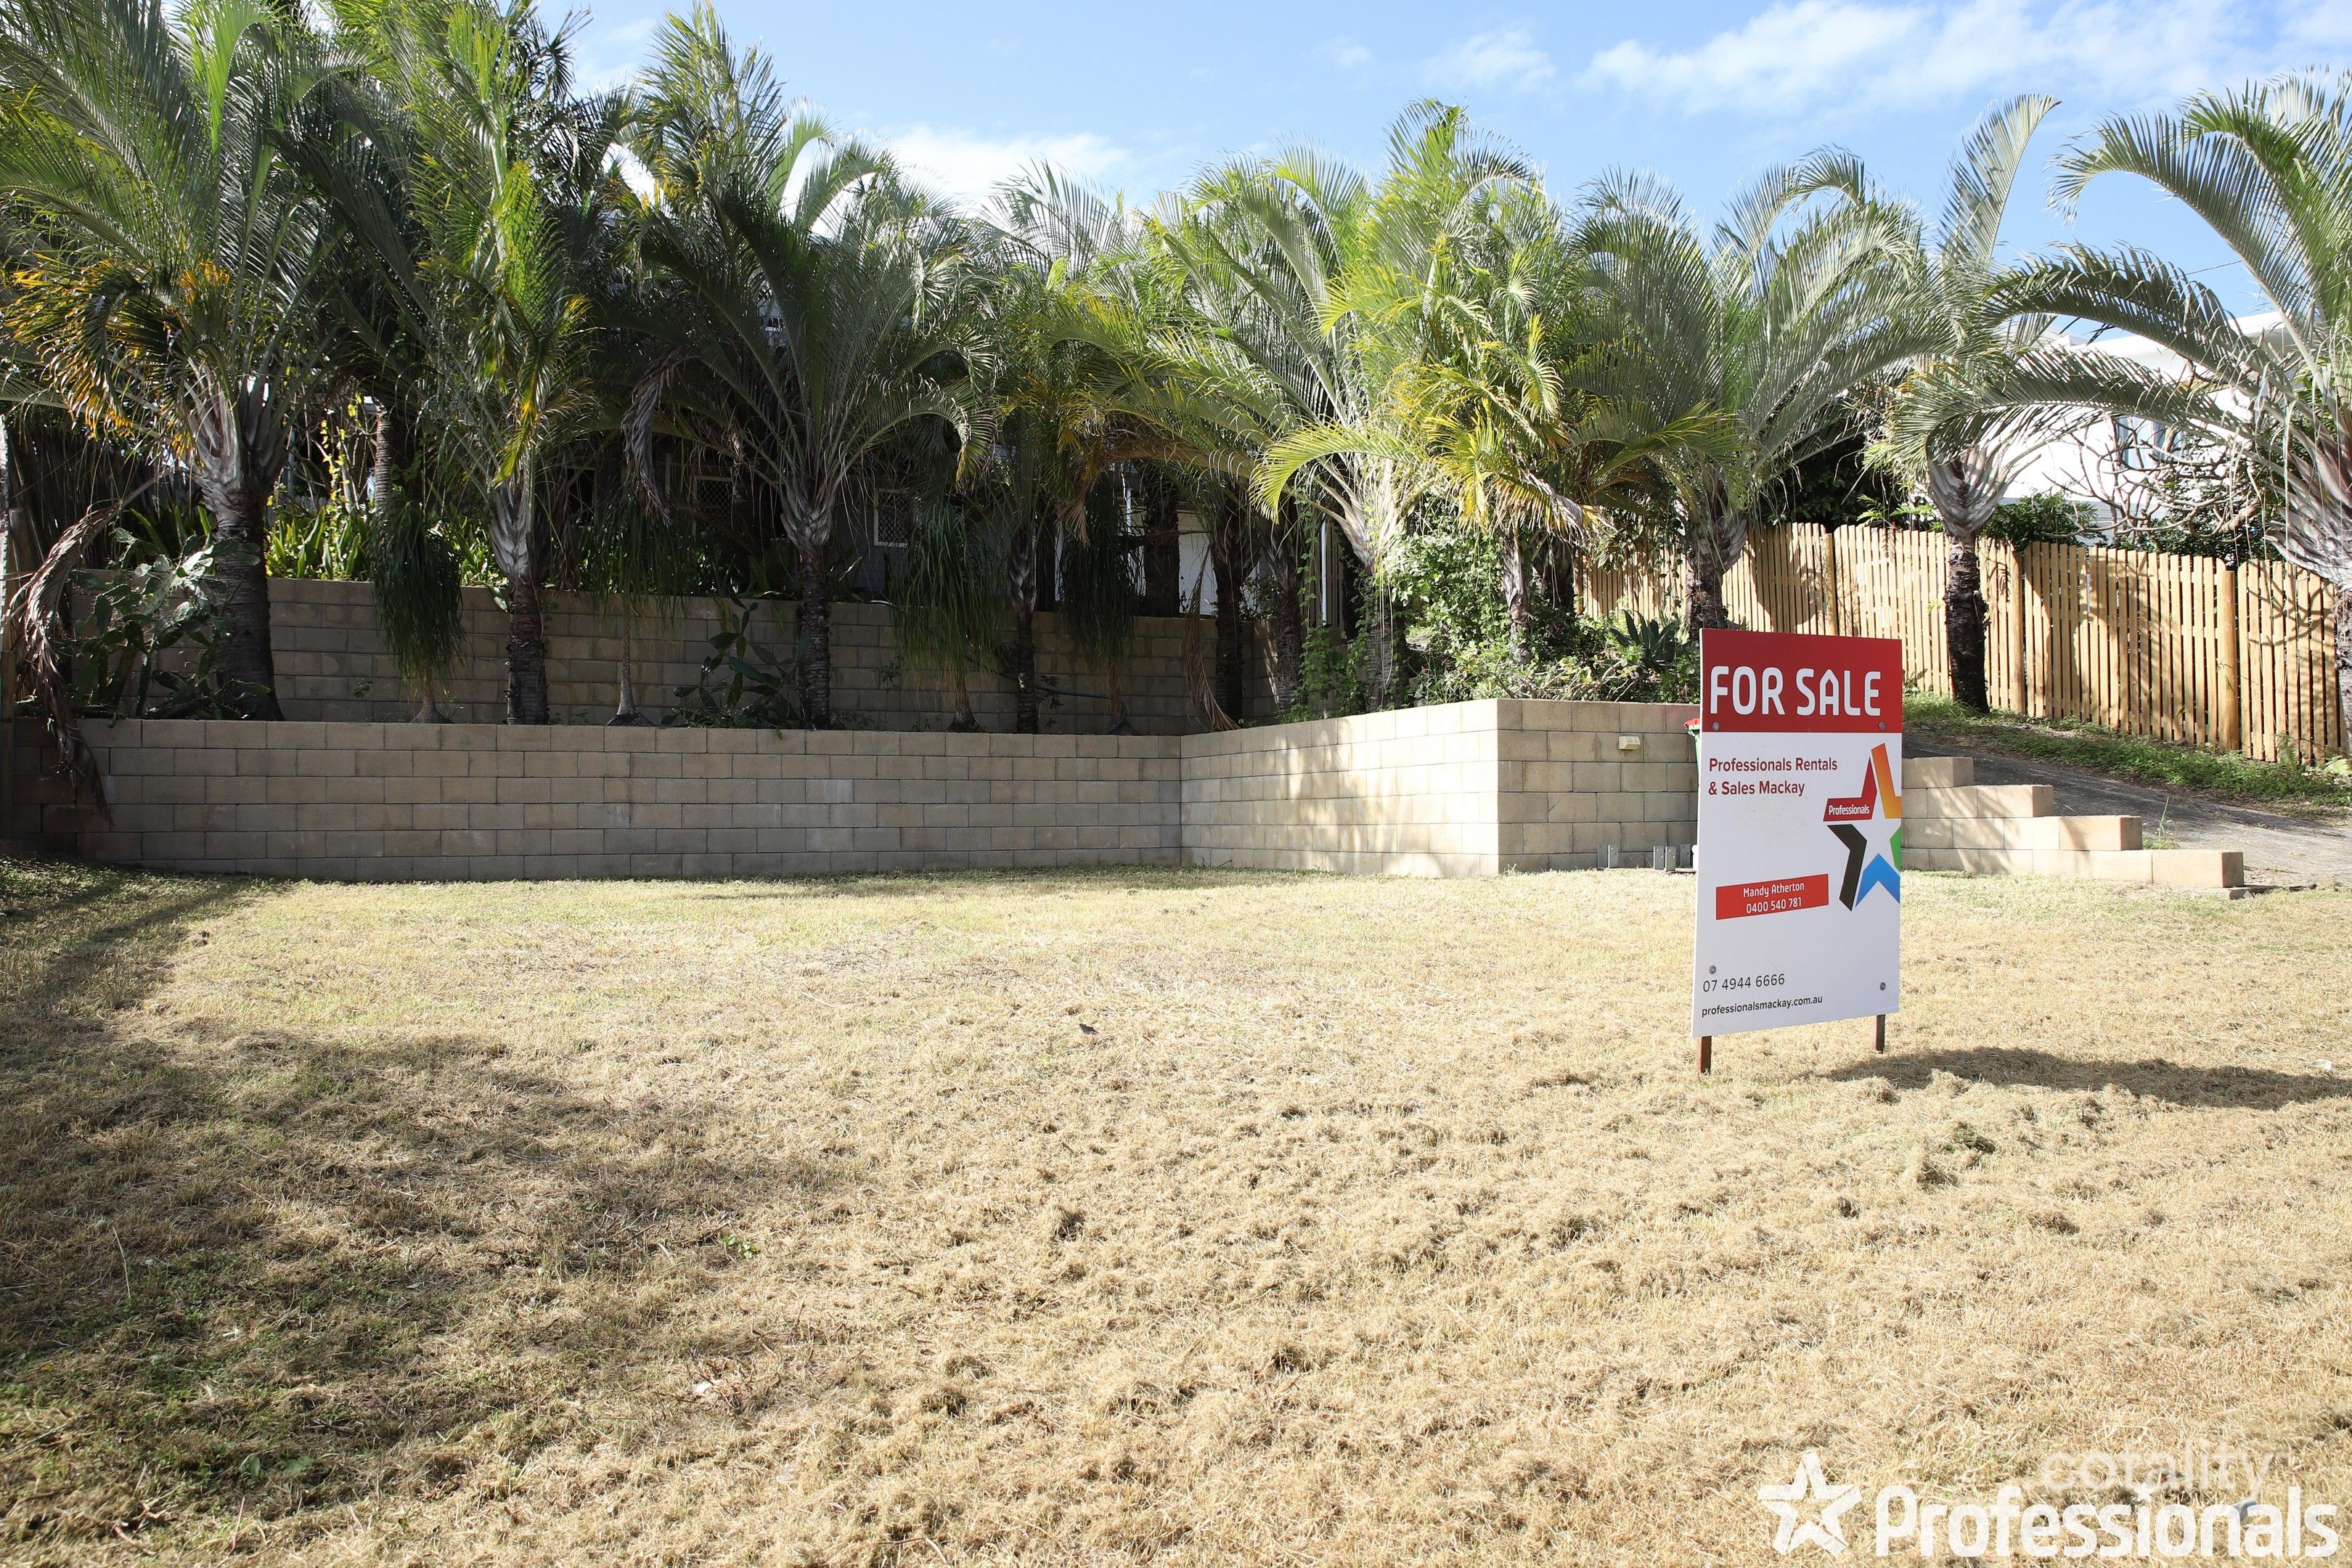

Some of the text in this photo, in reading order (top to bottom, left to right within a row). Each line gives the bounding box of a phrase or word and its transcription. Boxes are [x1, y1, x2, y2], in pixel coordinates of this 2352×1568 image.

[1710, 665, 1882, 716] FOR SALE
[1709, 757, 1838, 772] Professionals Rentals
[1708, 780, 1805, 797] & Sales Mackay
[1828, 804, 1870, 816] Professionals
[1743, 882, 1805, 898] Mandy Atherton
[1746, 897, 1802, 914] 0400 540 781
[1703, 973, 1785, 992] 07 4944 6666
[1702, 995, 1823, 1018] professionalsmackay.com.au
